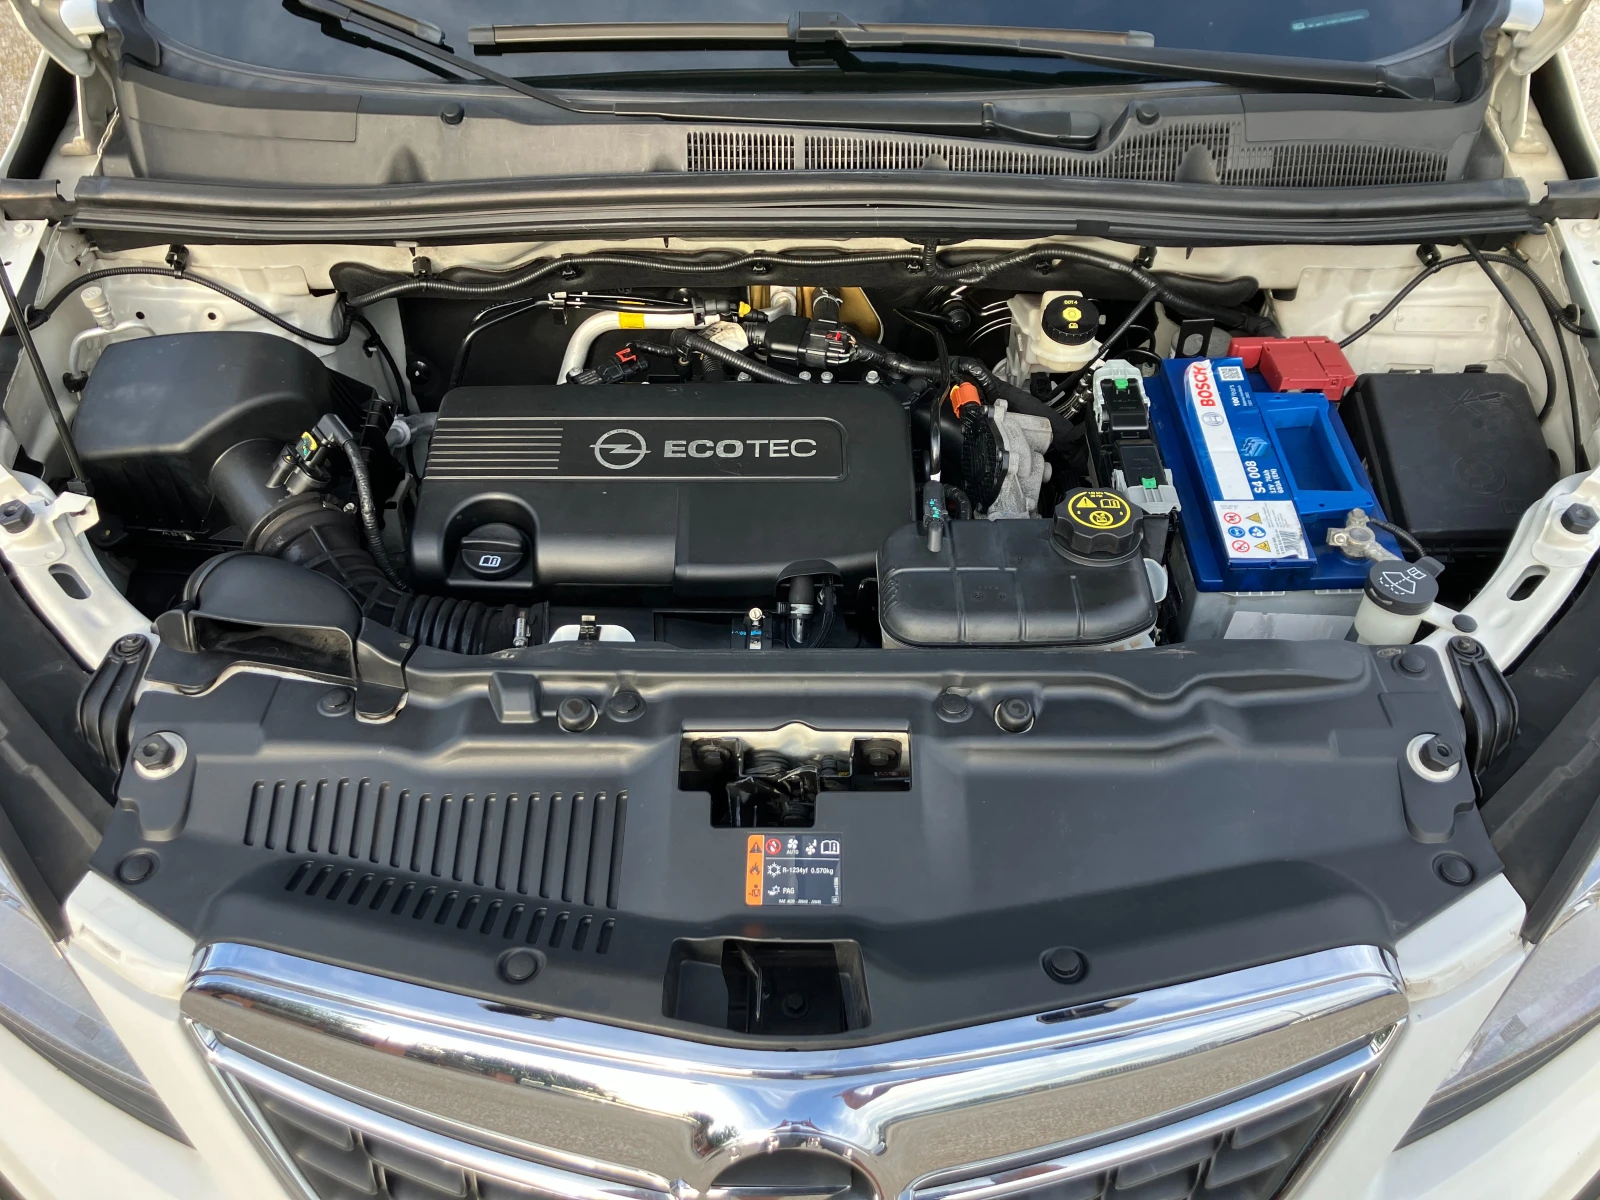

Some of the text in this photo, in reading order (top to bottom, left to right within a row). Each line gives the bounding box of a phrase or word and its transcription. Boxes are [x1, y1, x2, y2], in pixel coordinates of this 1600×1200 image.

[1193, 365, 1216, 407] BOSCH
[664, 438, 818, 458] ECOTEC
[1245, 460, 1266, 494] S4 008
[782, 866, 834, 876] R-1234yf 0.570kg
